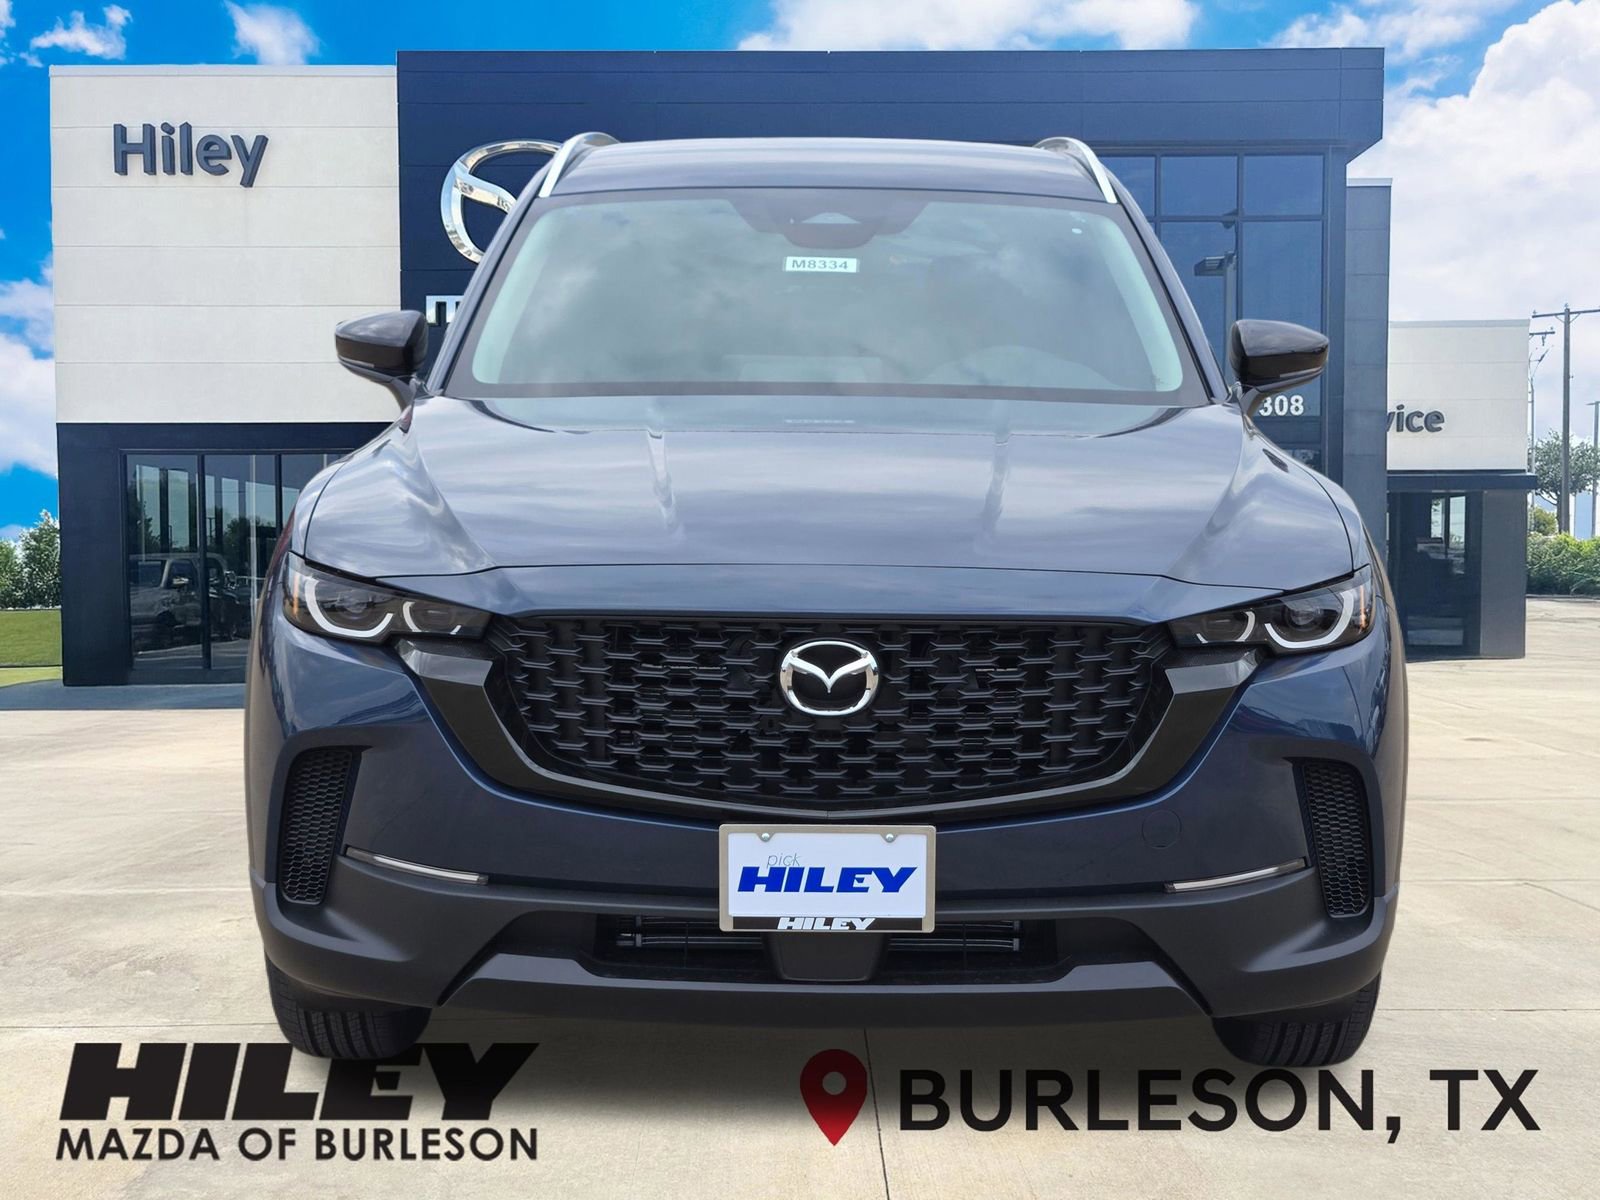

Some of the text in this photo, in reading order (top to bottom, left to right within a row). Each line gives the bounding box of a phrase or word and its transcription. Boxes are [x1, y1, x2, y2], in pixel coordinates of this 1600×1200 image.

[113, 121, 269, 188] Hiley
[792, 259, 848, 269] M8334
[766, 853, 801, 868] pick
[737, 866, 918, 893] HILEY
[777, 917, 876, 930] HILEY
